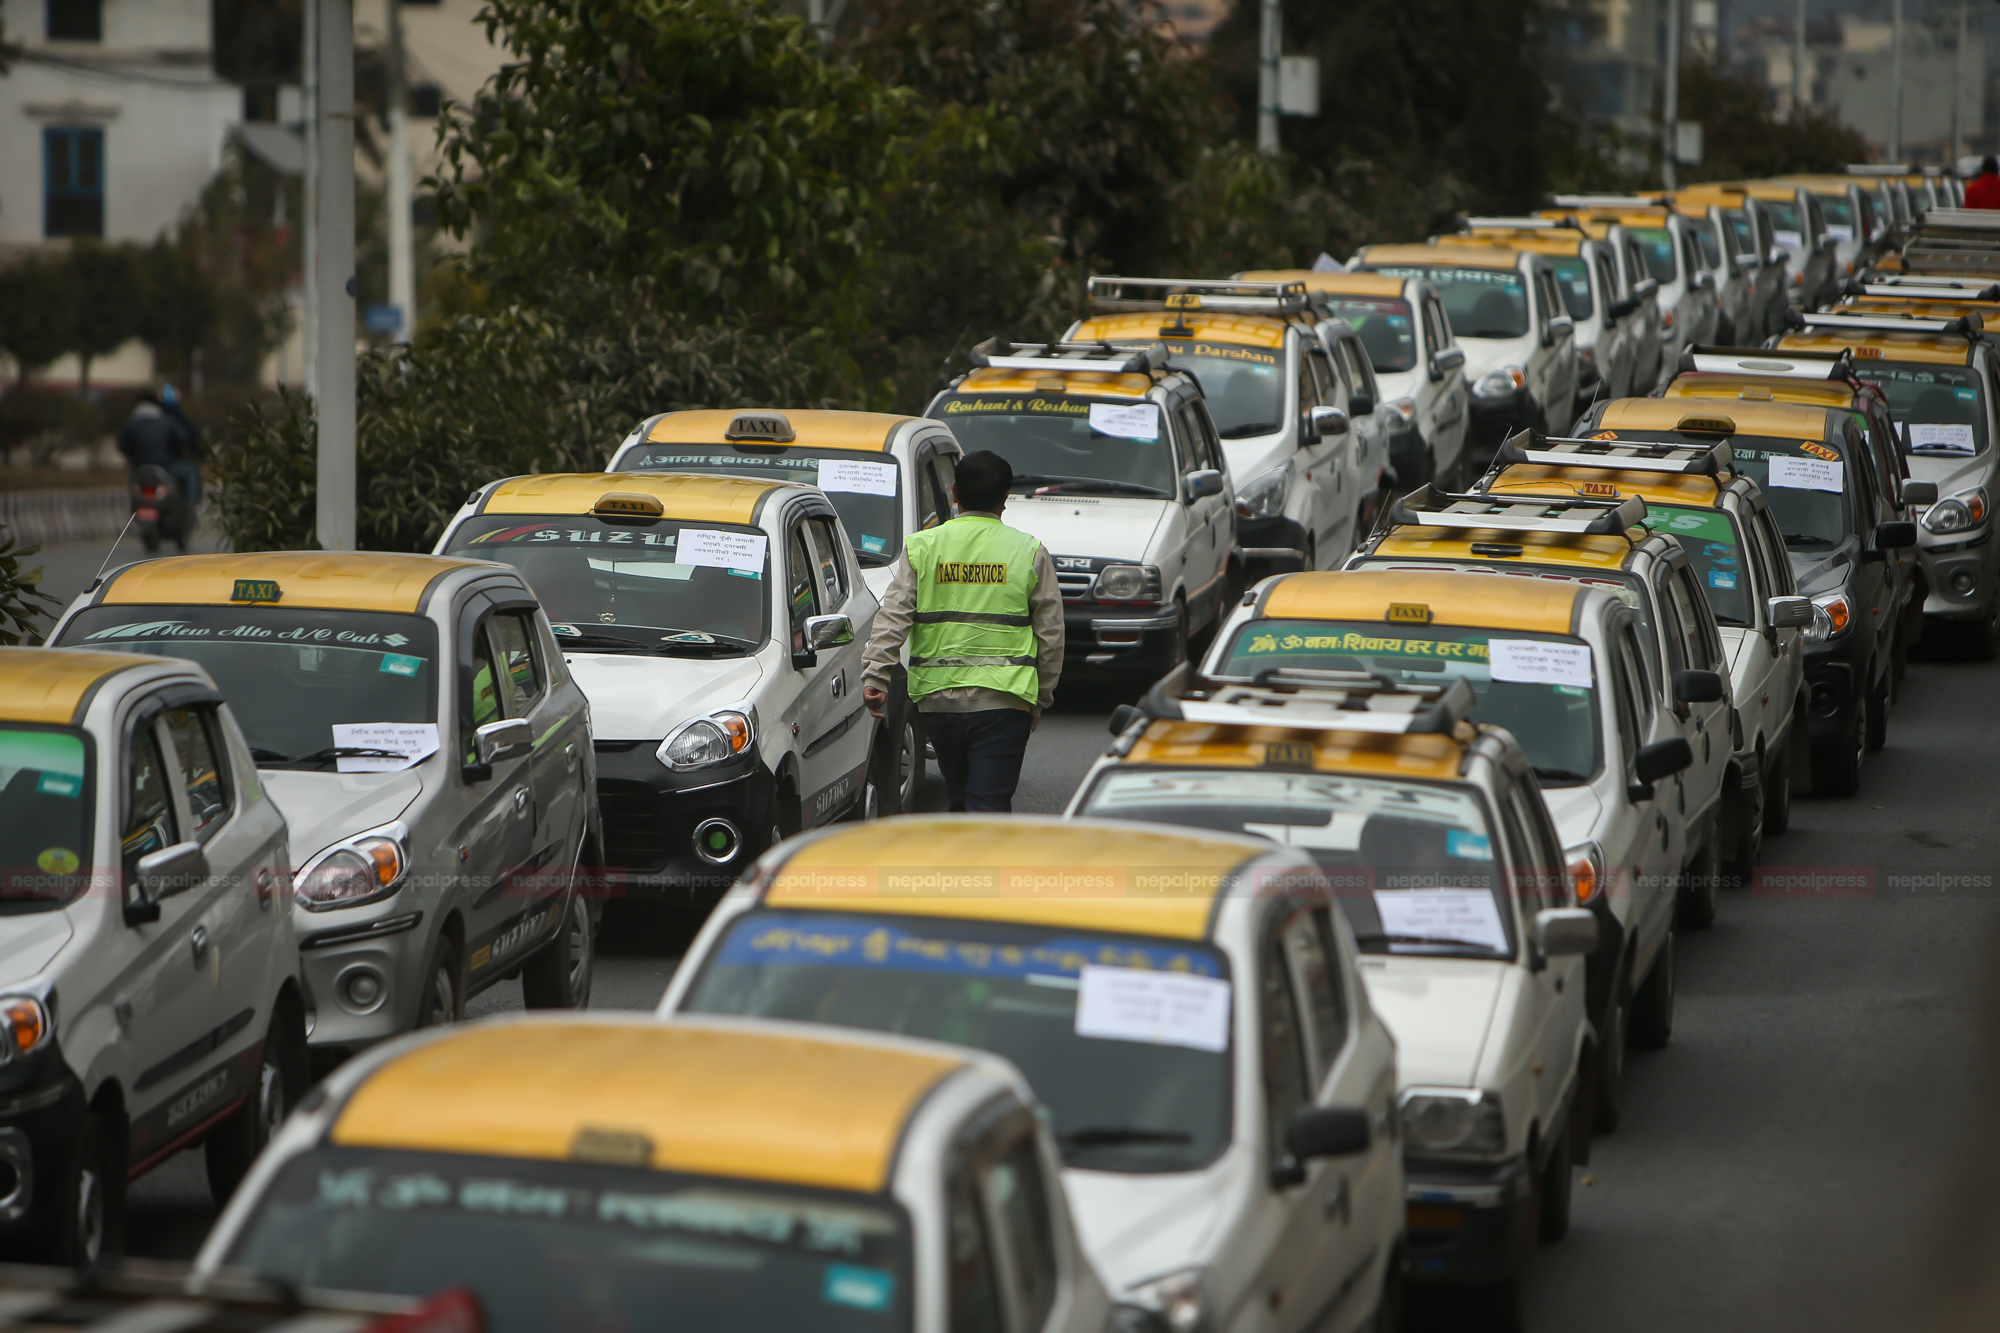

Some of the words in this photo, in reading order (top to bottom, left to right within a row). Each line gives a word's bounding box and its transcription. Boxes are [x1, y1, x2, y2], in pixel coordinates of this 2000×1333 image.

[1194, 344, 1275, 364] Darshan
[1857, 347, 1879, 357] TAXI
[944, 399, 1011, 413] Roshani
[1012, 400, 1023, 411] &
[735, 418, 779, 433] TAXI
[1692, 420, 1720, 428] TAXI
[1805, 441, 1839, 461] TAXI
[655, 455, 707, 464] आमा
[1585, 483, 1613, 495] TAXI
[610, 501, 645, 511] TAXI
[1056, 557, 1093, 569] जय
[939, 563, 960, 583] TAXI
[962, 564, 1004, 583] SERVICE
[236, 583, 274, 599] TAXI
[1393, 607, 1424, 619] TAXI
[217, 625, 272, 638] Alto
[277, 628, 331, 642] A/C
[336, 630, 380, 645] Cab
[1404, 639, 1434, 654] हर
[1435, 641, 1466, 656] हर
